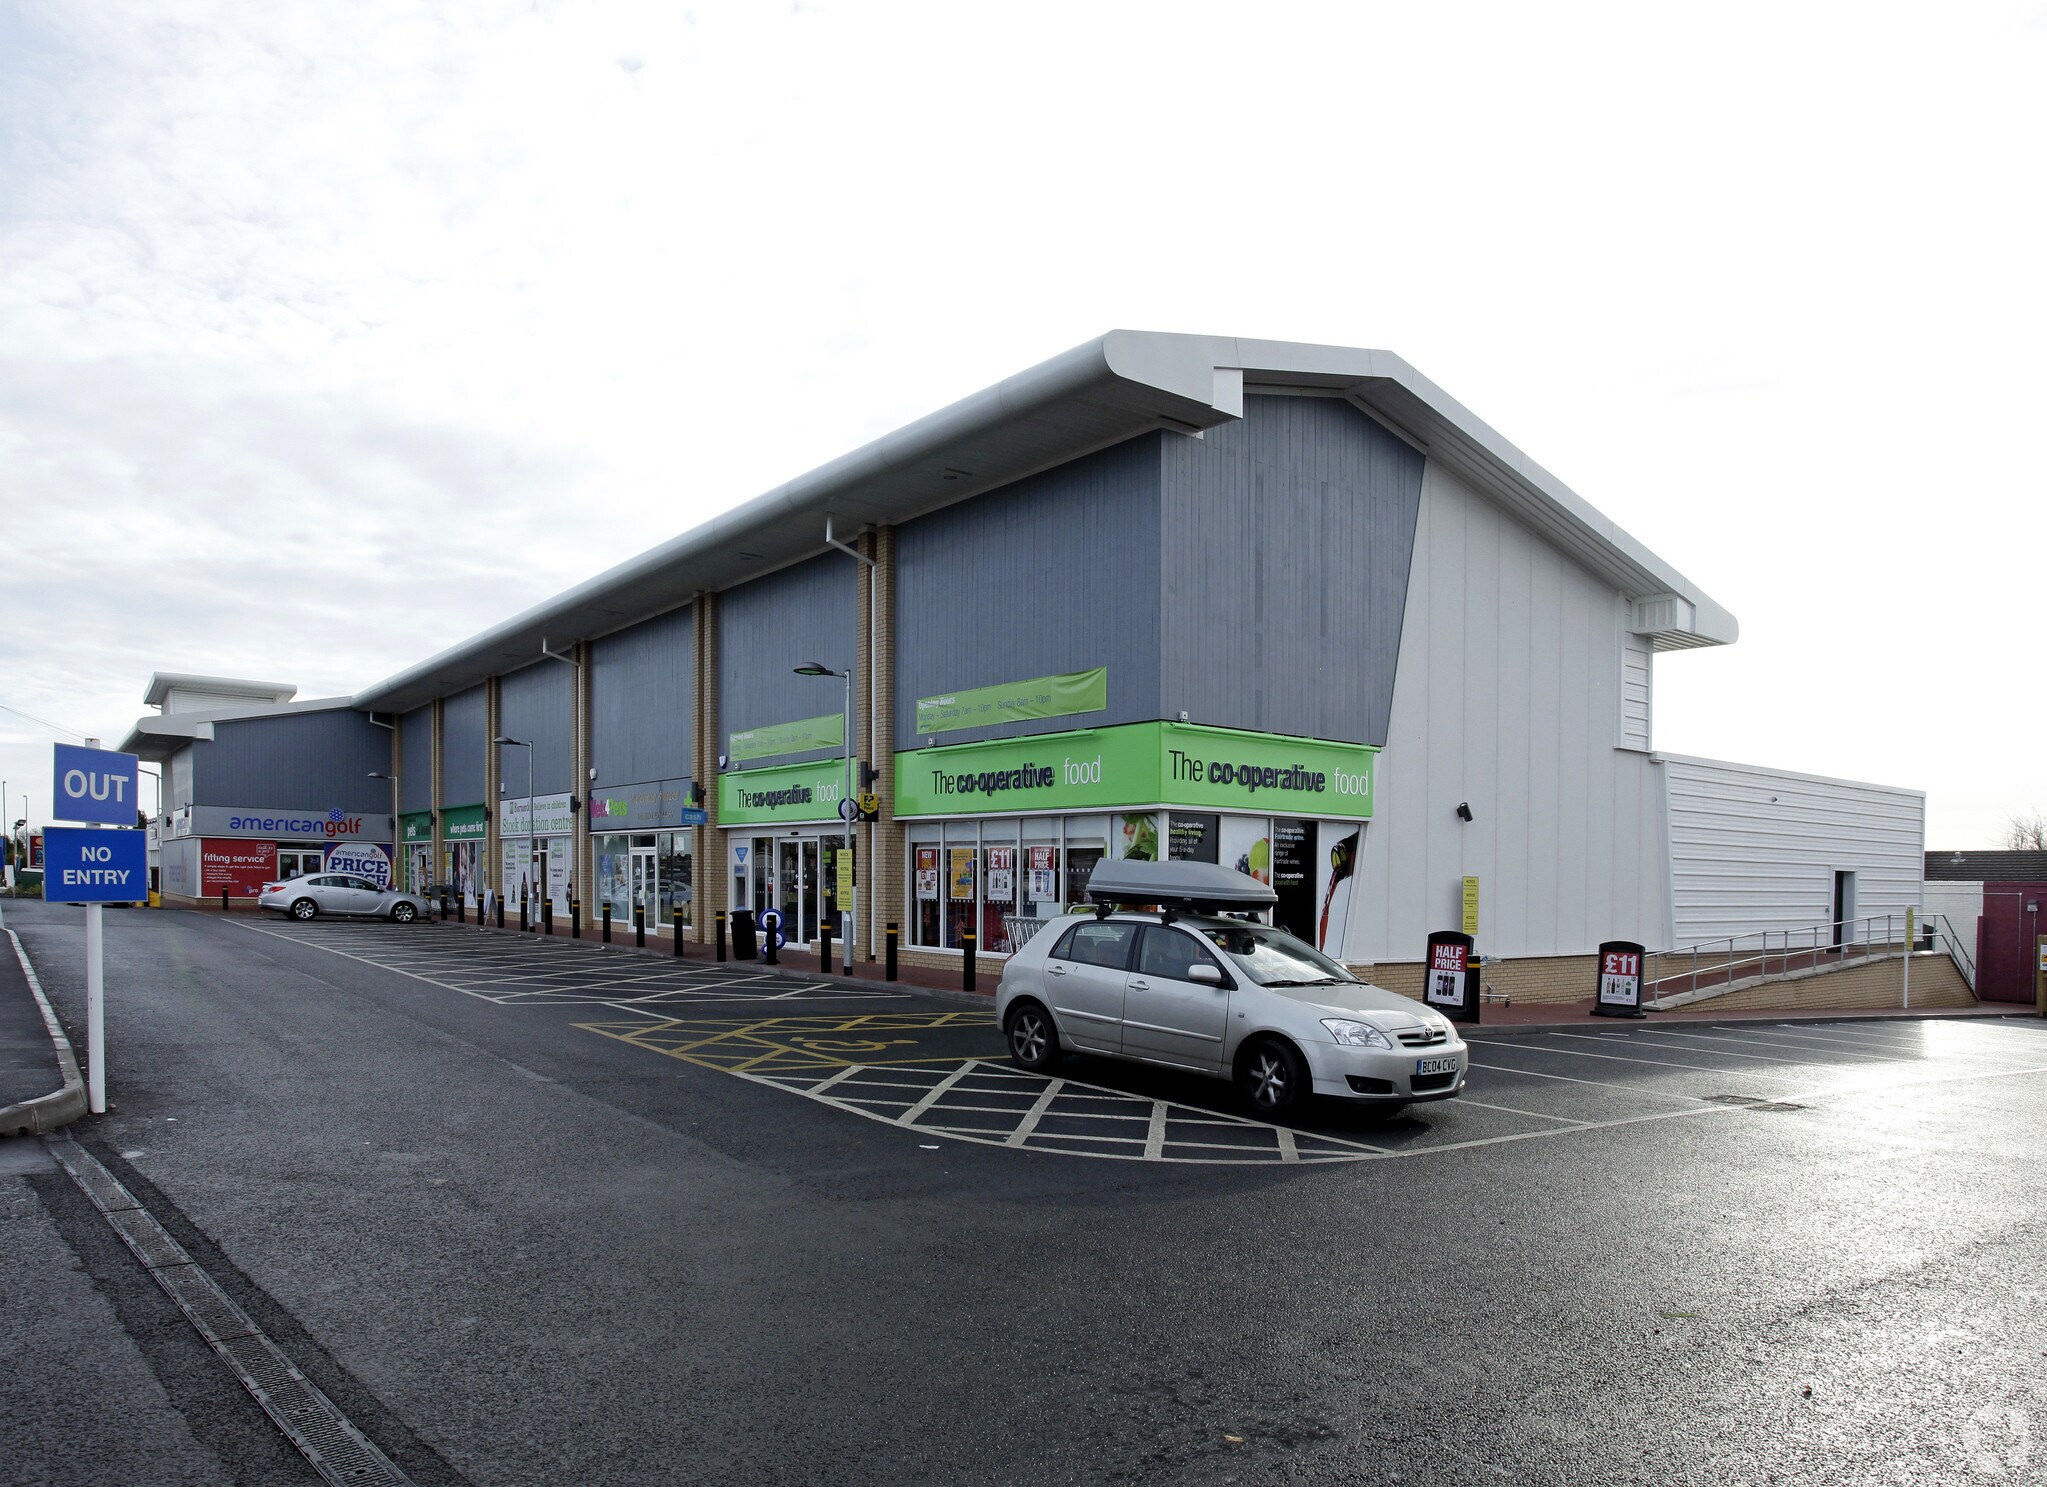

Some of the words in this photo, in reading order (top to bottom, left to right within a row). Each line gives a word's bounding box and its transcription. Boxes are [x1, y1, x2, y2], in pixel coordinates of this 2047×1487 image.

[932, 770, 955, 795] The
[957, 762, 1055, 797] co-operative
[1064, 755, 1101, 785] food
[1168, 750, 1203, 782] The
[1209, 761, 1326, 793] co-operative
[1334, 767, 1369, 796] food
[64, 769, 129, 803] OUT
[737, 789, 752, 809] The
[752, 784, 813, 811] co-operative
[816, 779, 839, 802] food
[685, 812, 702, 821] cash
[502, 818, 520, 833] Stock
[81, 846, 112, 863] NO
[204, 852, 230, 864] fitting
[232, 855, 265, 863] service
[921, 850, 932, 859] NEW
[990, 849, 1010, 869] £11
[1034, 852, 1050, 861] HALF
[330, 857, 388, 874] PRICE
[1034, 860, 1050, 869] PRICE
[63, 869, 131, 885] ENTRY
[1436, 945, 1463, 959] HALF
[1435, 959, 1462, 971] PRICE
[1605, 953, 1637, 975] £11
